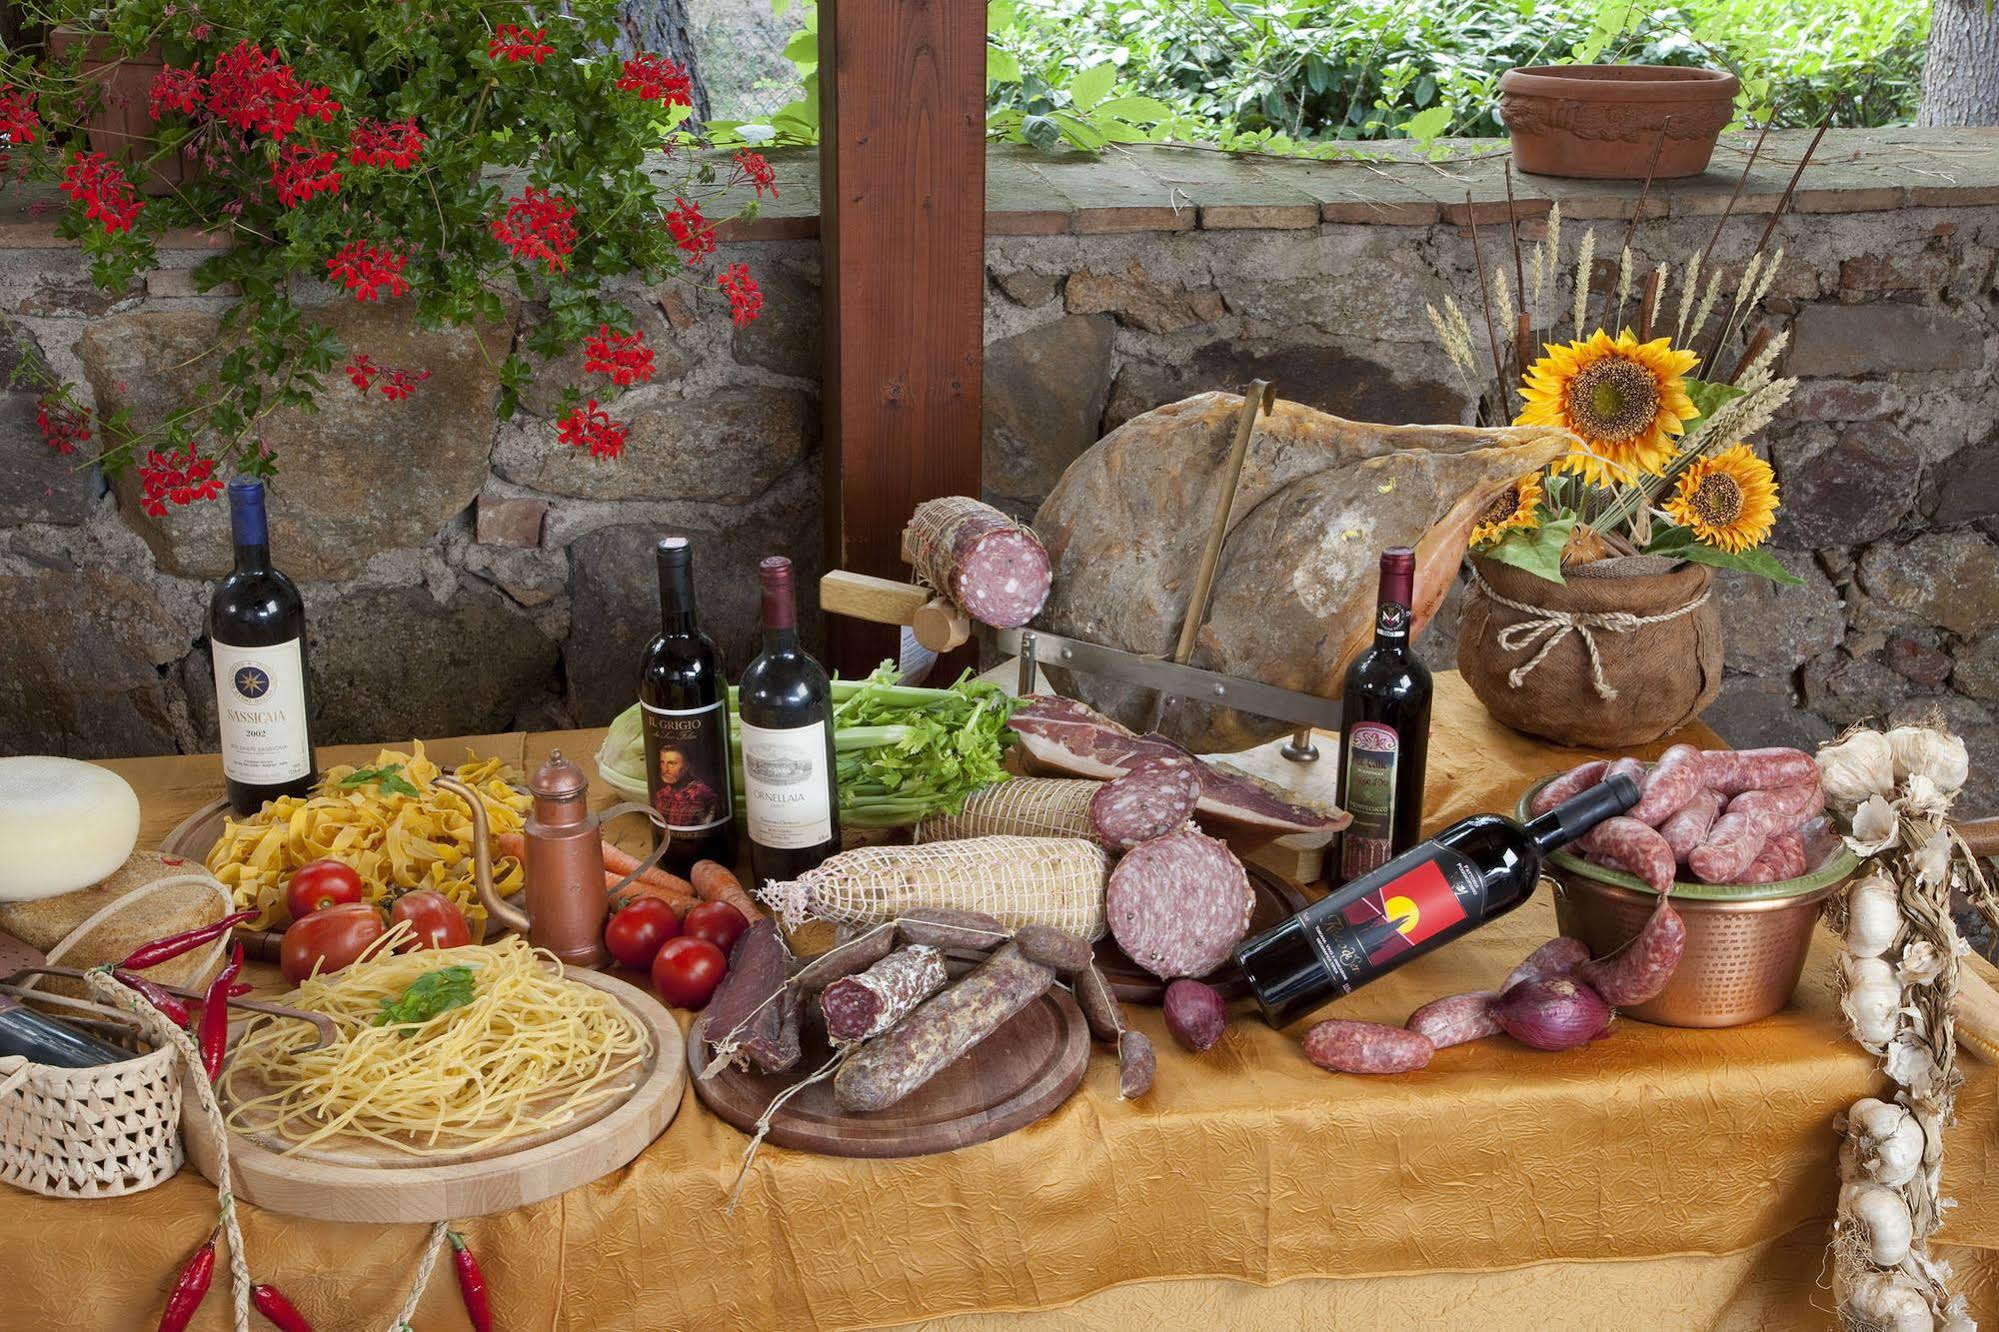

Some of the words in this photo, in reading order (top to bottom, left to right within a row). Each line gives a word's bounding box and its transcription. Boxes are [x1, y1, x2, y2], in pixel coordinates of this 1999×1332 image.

[227, 709, 287, 724] SASSICAIA
[648, 716, 657, 727] IL
[659, 719, 702, 730] GRIGIO
[246, 729, 266, 738] 2002
[753, 790, 805, 803] ORNELLAIA
